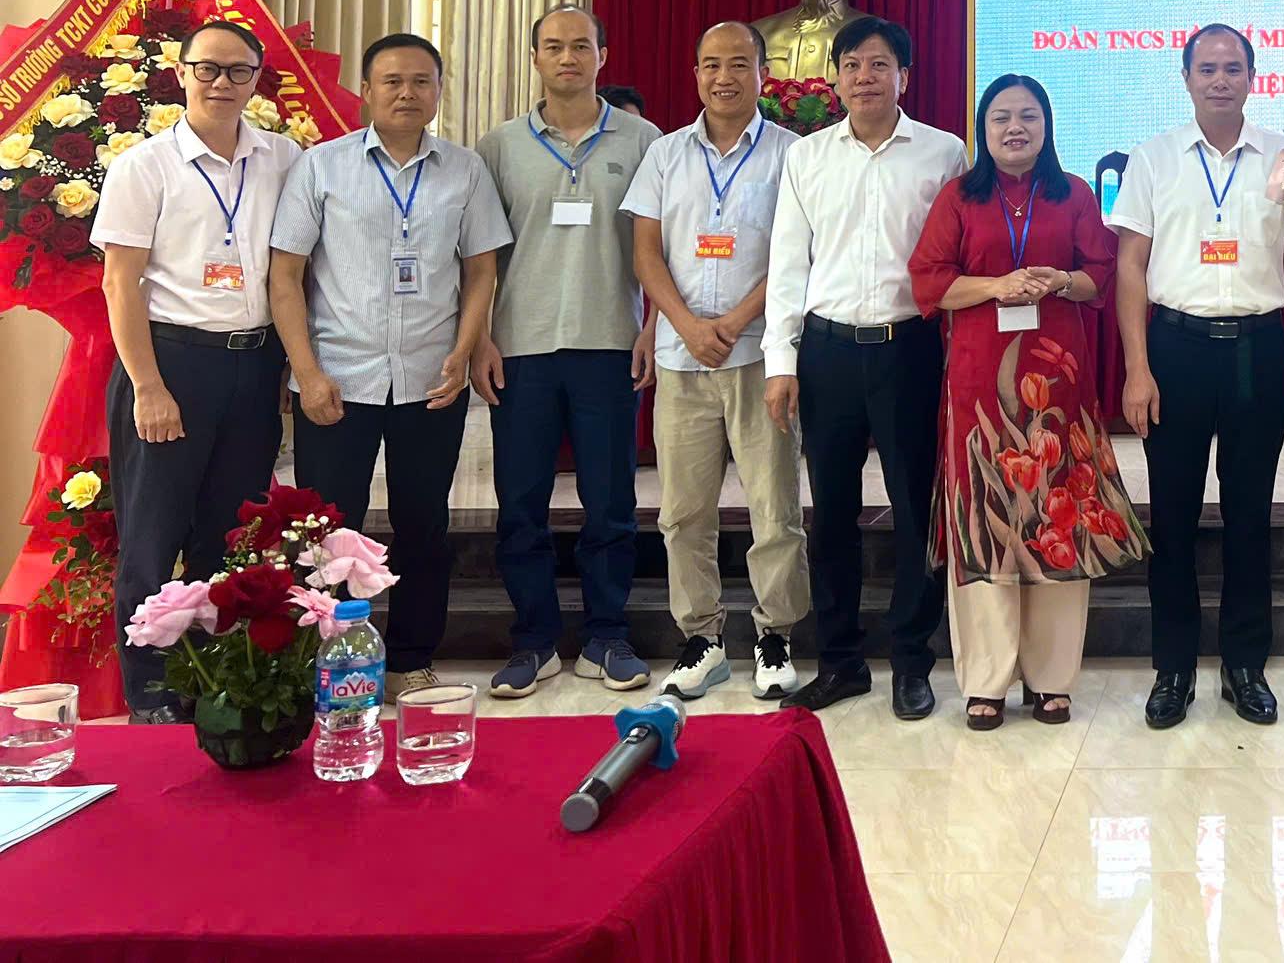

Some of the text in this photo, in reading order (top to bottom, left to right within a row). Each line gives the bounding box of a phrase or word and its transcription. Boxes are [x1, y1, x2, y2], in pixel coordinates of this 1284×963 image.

[9, 37, 64, 93] TRƯỜNG
[55, 4, 94, 49] TCKT
[1033, 25, 1099, 49] ĐOÀN
[1105, 30, 1165, 50] TNCS
